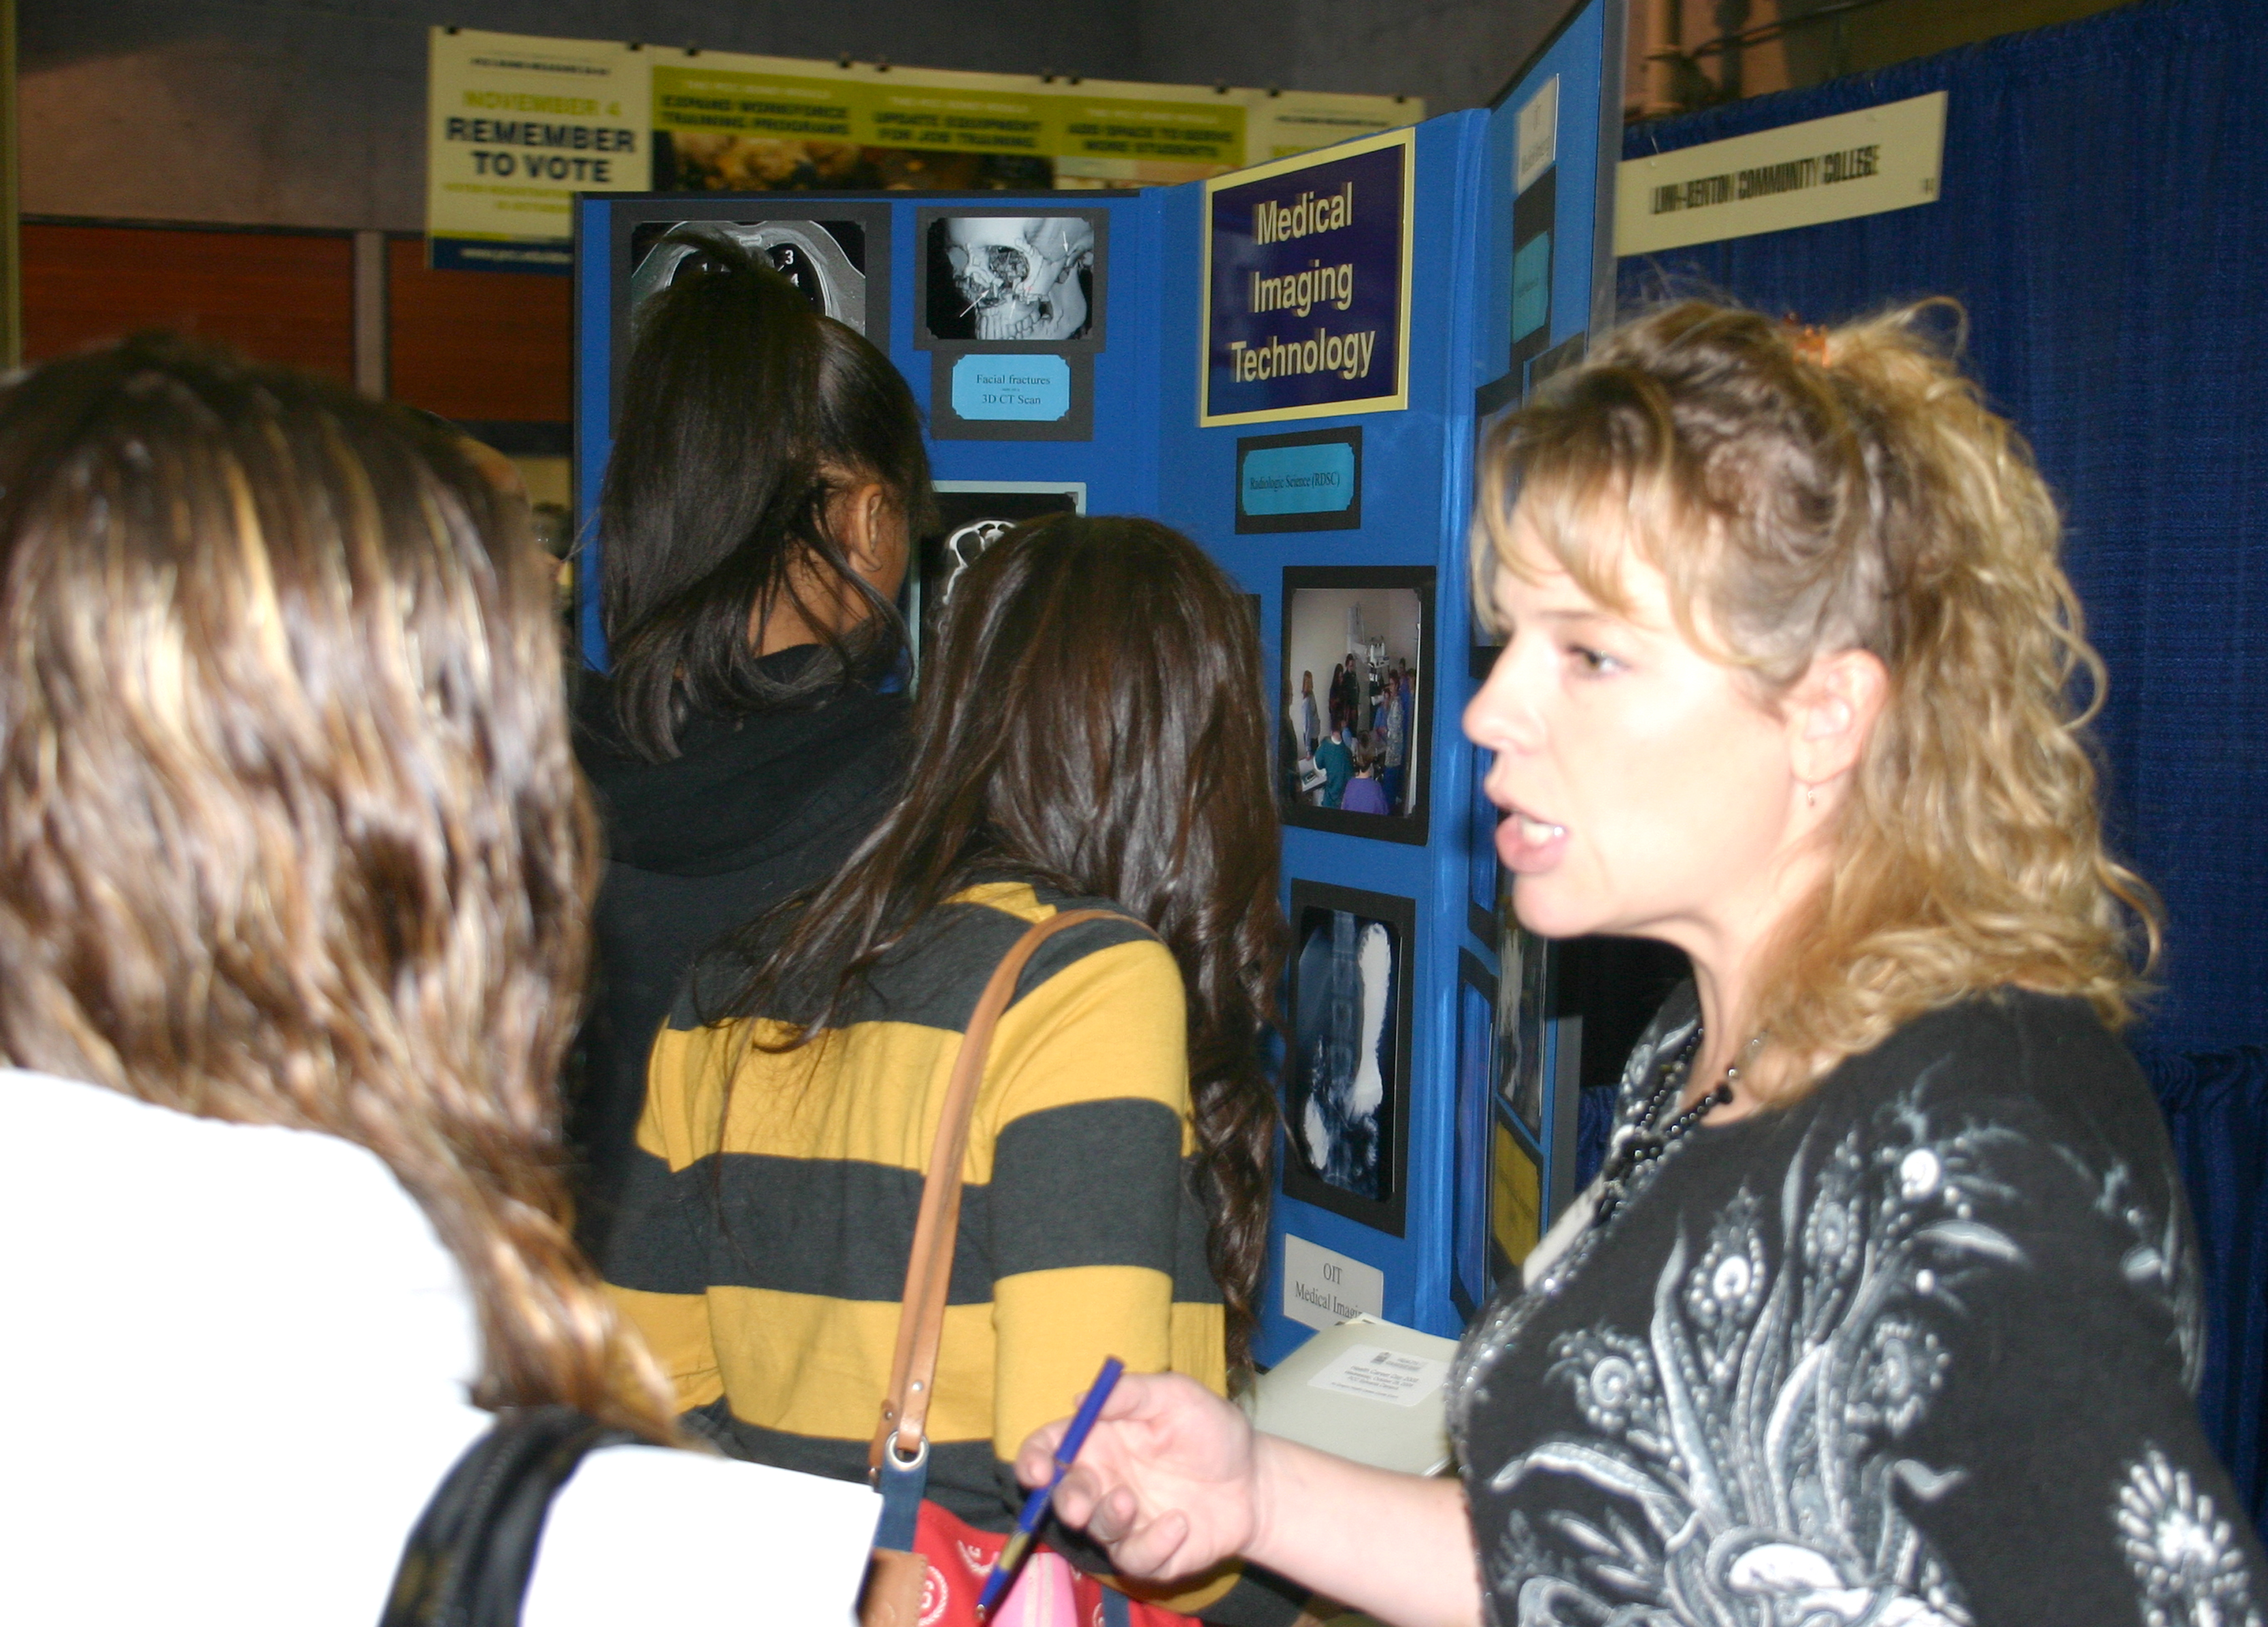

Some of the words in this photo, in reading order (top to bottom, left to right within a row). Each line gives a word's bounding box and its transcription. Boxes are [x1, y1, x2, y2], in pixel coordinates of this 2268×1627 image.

[463, 90, 601, 116] NOVEMBER
[446, 117, 635, 152] REMEMBER
[472, 151, 515, 176] TO
[523, 155, 611, 182] VOTE
[1737, 157, 1820, 200] COMMUNITY
[1821, 144, 1881, 185] COLLEGE
[1256, 181, 1353, 246] Medical
[784, 250, 794, 265] 3
[1252, 259, 1353, 317] Imaging
[1230, 328, 1375, 384] Technology
[976, 374, 1005, 384] Facial
[1009, 374, 1050, 385] fractures
[982, 394, 997, 404] 3D
[999, 395, 1015, 404] CT
[1018, 395, 1041, 405] Scan
[1286, 474, 1311, 489] Science
[1312, 472, 1340, 489] (RDSC)
[1323, 1263, 1342, 1285] OIT
[1295, 1281, 1331, 1311] Medical
